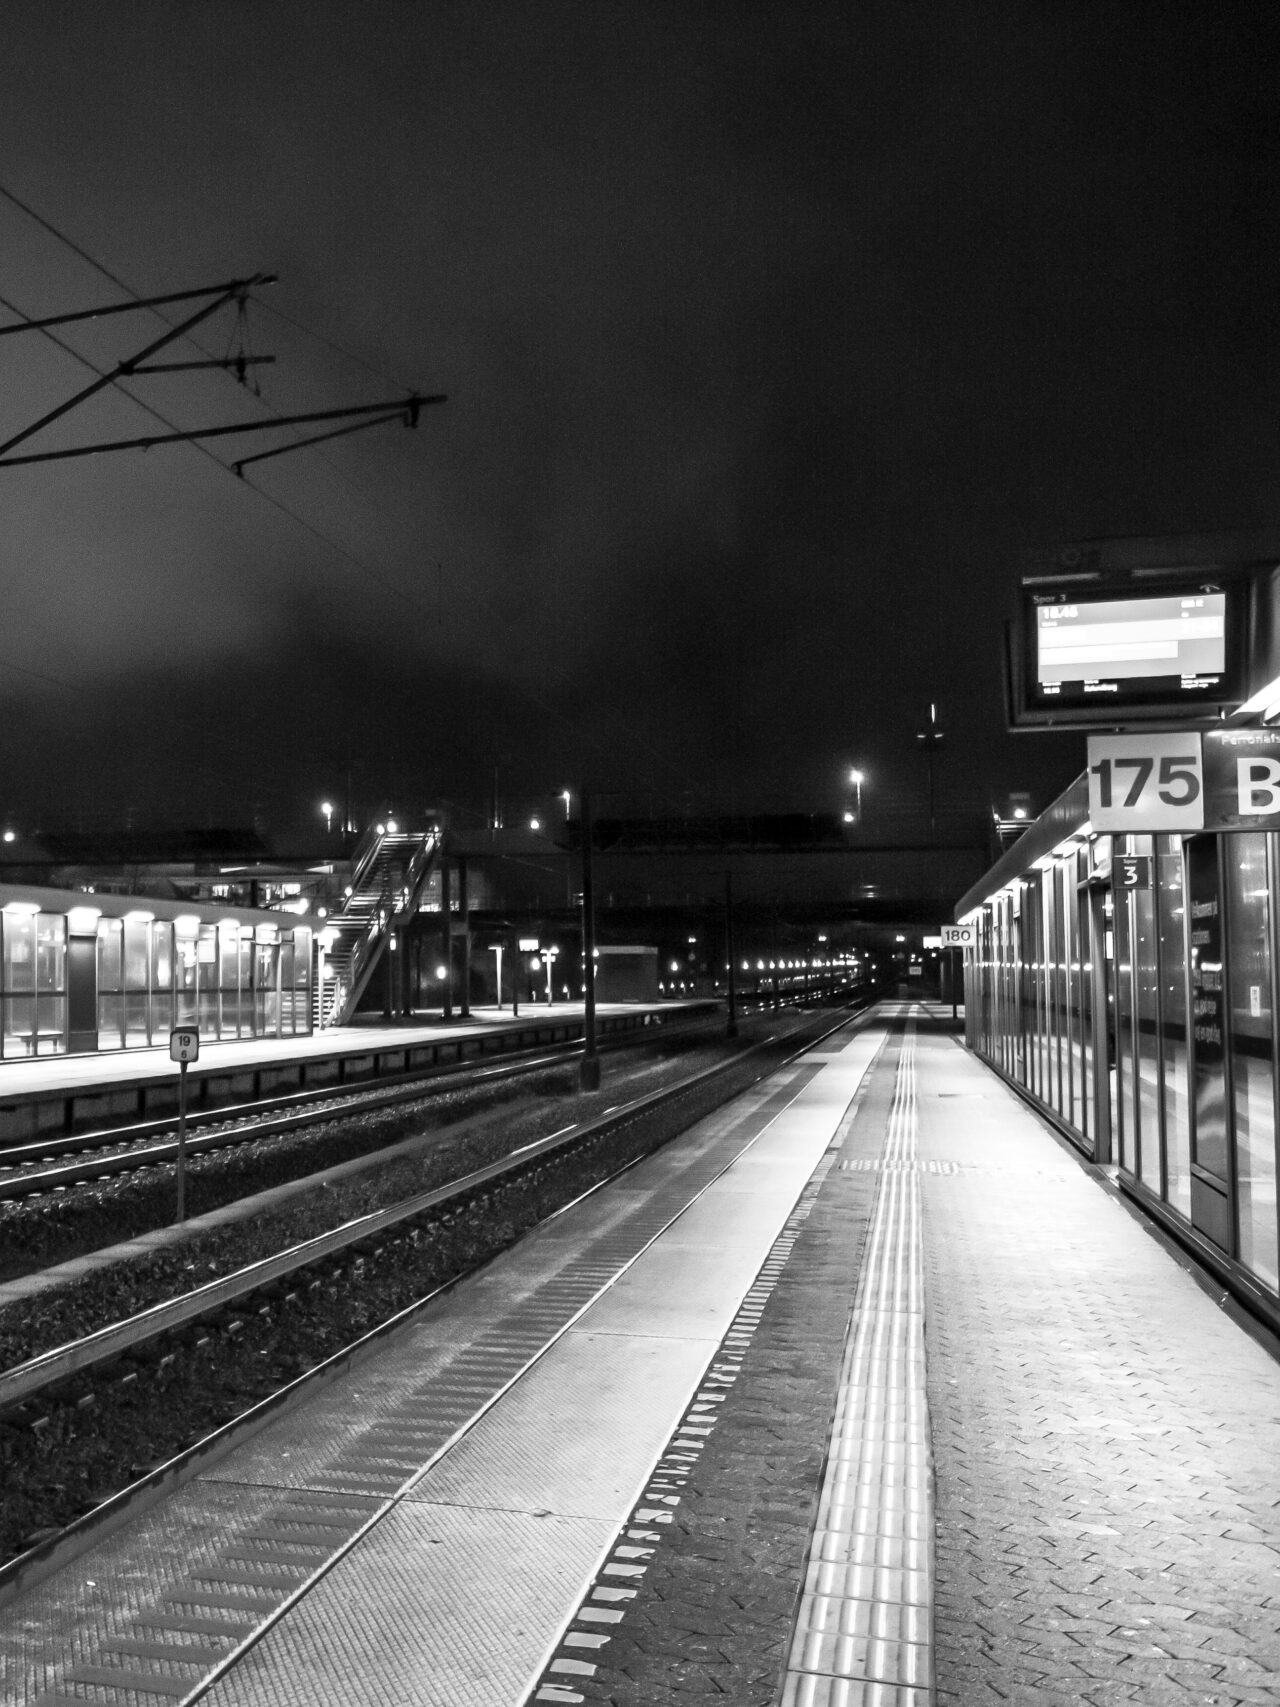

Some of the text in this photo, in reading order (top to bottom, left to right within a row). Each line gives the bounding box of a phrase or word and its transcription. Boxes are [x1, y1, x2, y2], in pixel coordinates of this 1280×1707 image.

[1091, 757, 1200, 808] 175
[1237, 757, 1280, 816] B
[1124, 866, 1138, 885] 3
[945, 930, 971, 942] 180
[178, 1036, 190, 1047] 19
